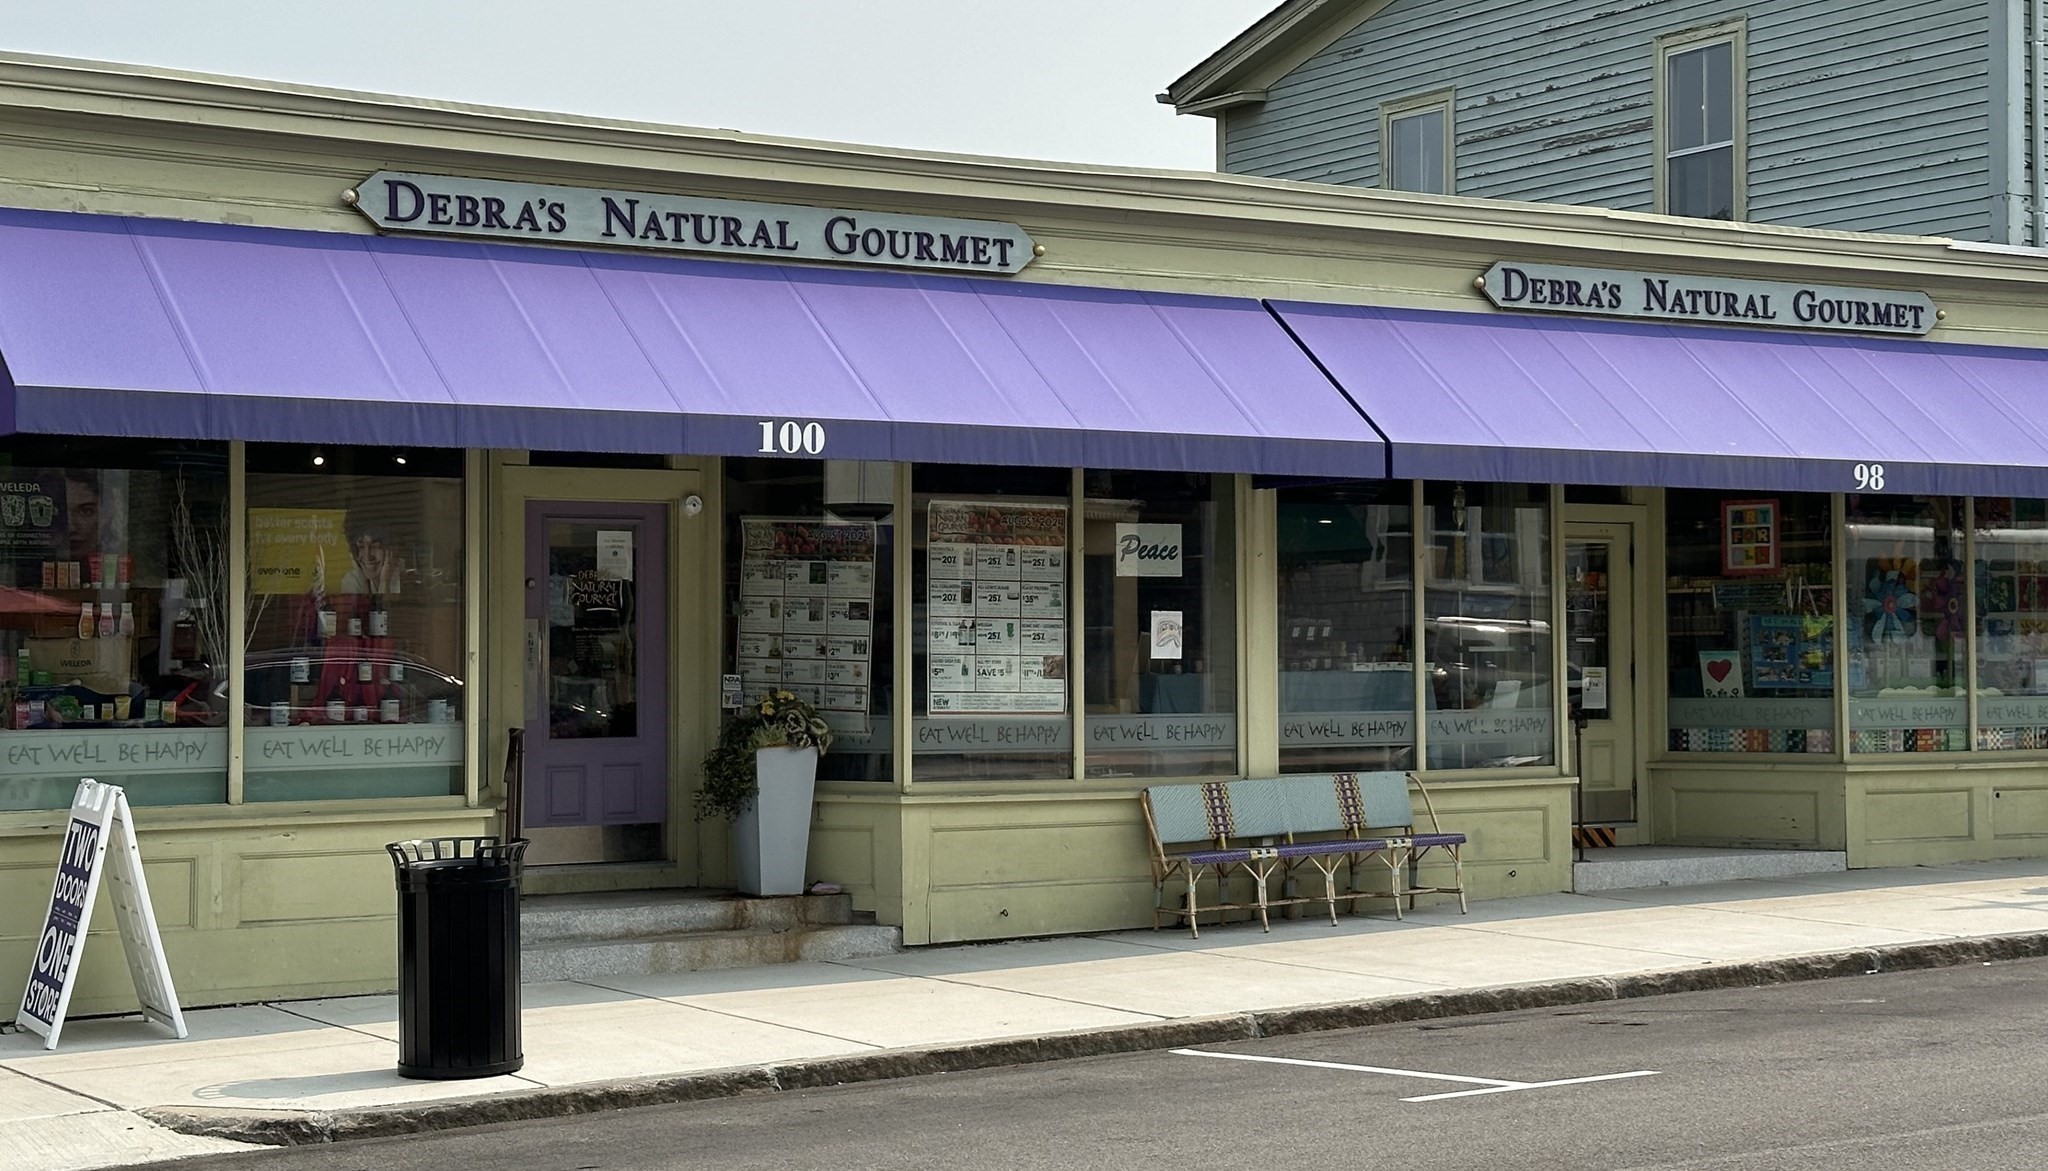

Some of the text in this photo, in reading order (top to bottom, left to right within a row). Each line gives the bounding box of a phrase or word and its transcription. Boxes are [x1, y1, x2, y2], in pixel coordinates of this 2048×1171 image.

[601, 196, 799, 251] NATURAL
[824, 215, 1014, 267] GOURMET
[1643, 277, 1777, 320] NATURAL
[1793, 289, 1924, 329] GOURMET
[758, 420, 826, 455] 100
[1853, 463, 1885, 491] 98
[1120, 533, 1178, 562] Peace
[1732, 527, 1769, 543] FOR
[60, 659, 92, 667] WELEDA
[977, 668, 996, 677] SAVE
[1709, 703, 1747, 721] WELL
[1858, 707, 1876, 721] EAT
[1877, 704, 1908, 721] WELL
[1912, 707, 1924, 721] BE
[919, 723, 1061, 744] EAT WELL BE HAPPY
[1094, 721, 1226, 742] EAT WELL BE HAPPY
[1284, 718, 1408, 739] EAT WELL BE HAPPY
[8, 737, 208, 766] EAT WELL BE HAPPY
[263, 735, 445, 759] EAT WELL BE HAPPY
[64, 823, 98, 873] TWO
[55, 873, 87, 911] DOORS
[39, 924, 76, 984] ONE
[26, 978, 60, 1023] STORE
